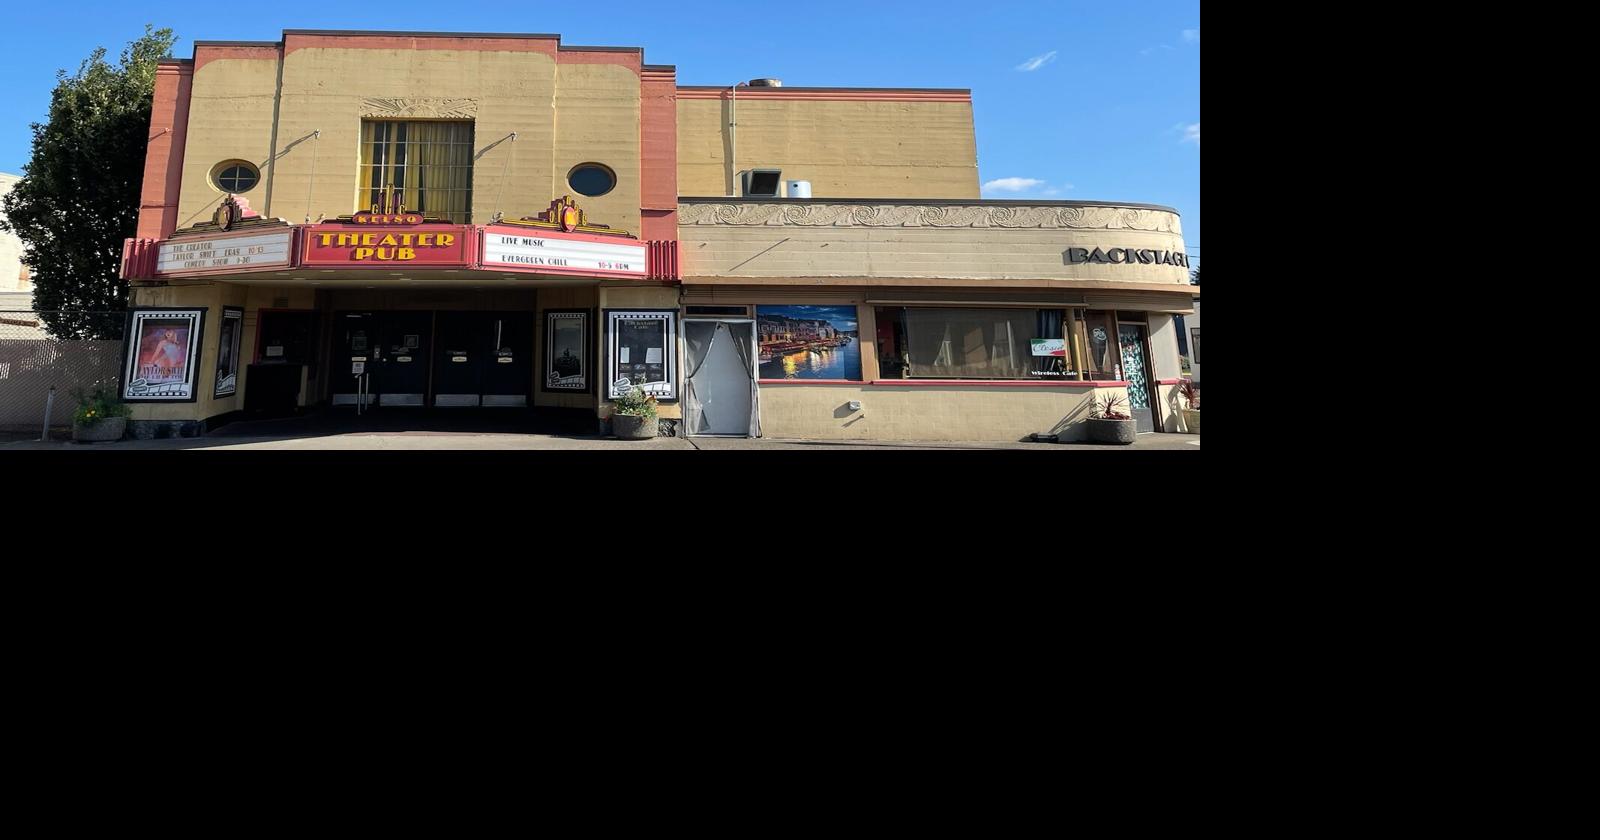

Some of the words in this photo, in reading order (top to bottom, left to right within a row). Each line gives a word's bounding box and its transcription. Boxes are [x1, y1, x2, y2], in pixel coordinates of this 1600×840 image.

[358, 215, 417, 223] KELSO
[316, 233, 456, 247] THEATER
[501, 236, 518, 245] LIVE
[522, 238, 544, 247] MUSIC
[354, 247, 417, 260] PUB
[502, 255, 544, 265] EVERGREEN
[548, 257, 568, 267] CHILL
[1033, 344, 1064, 352] Closed
